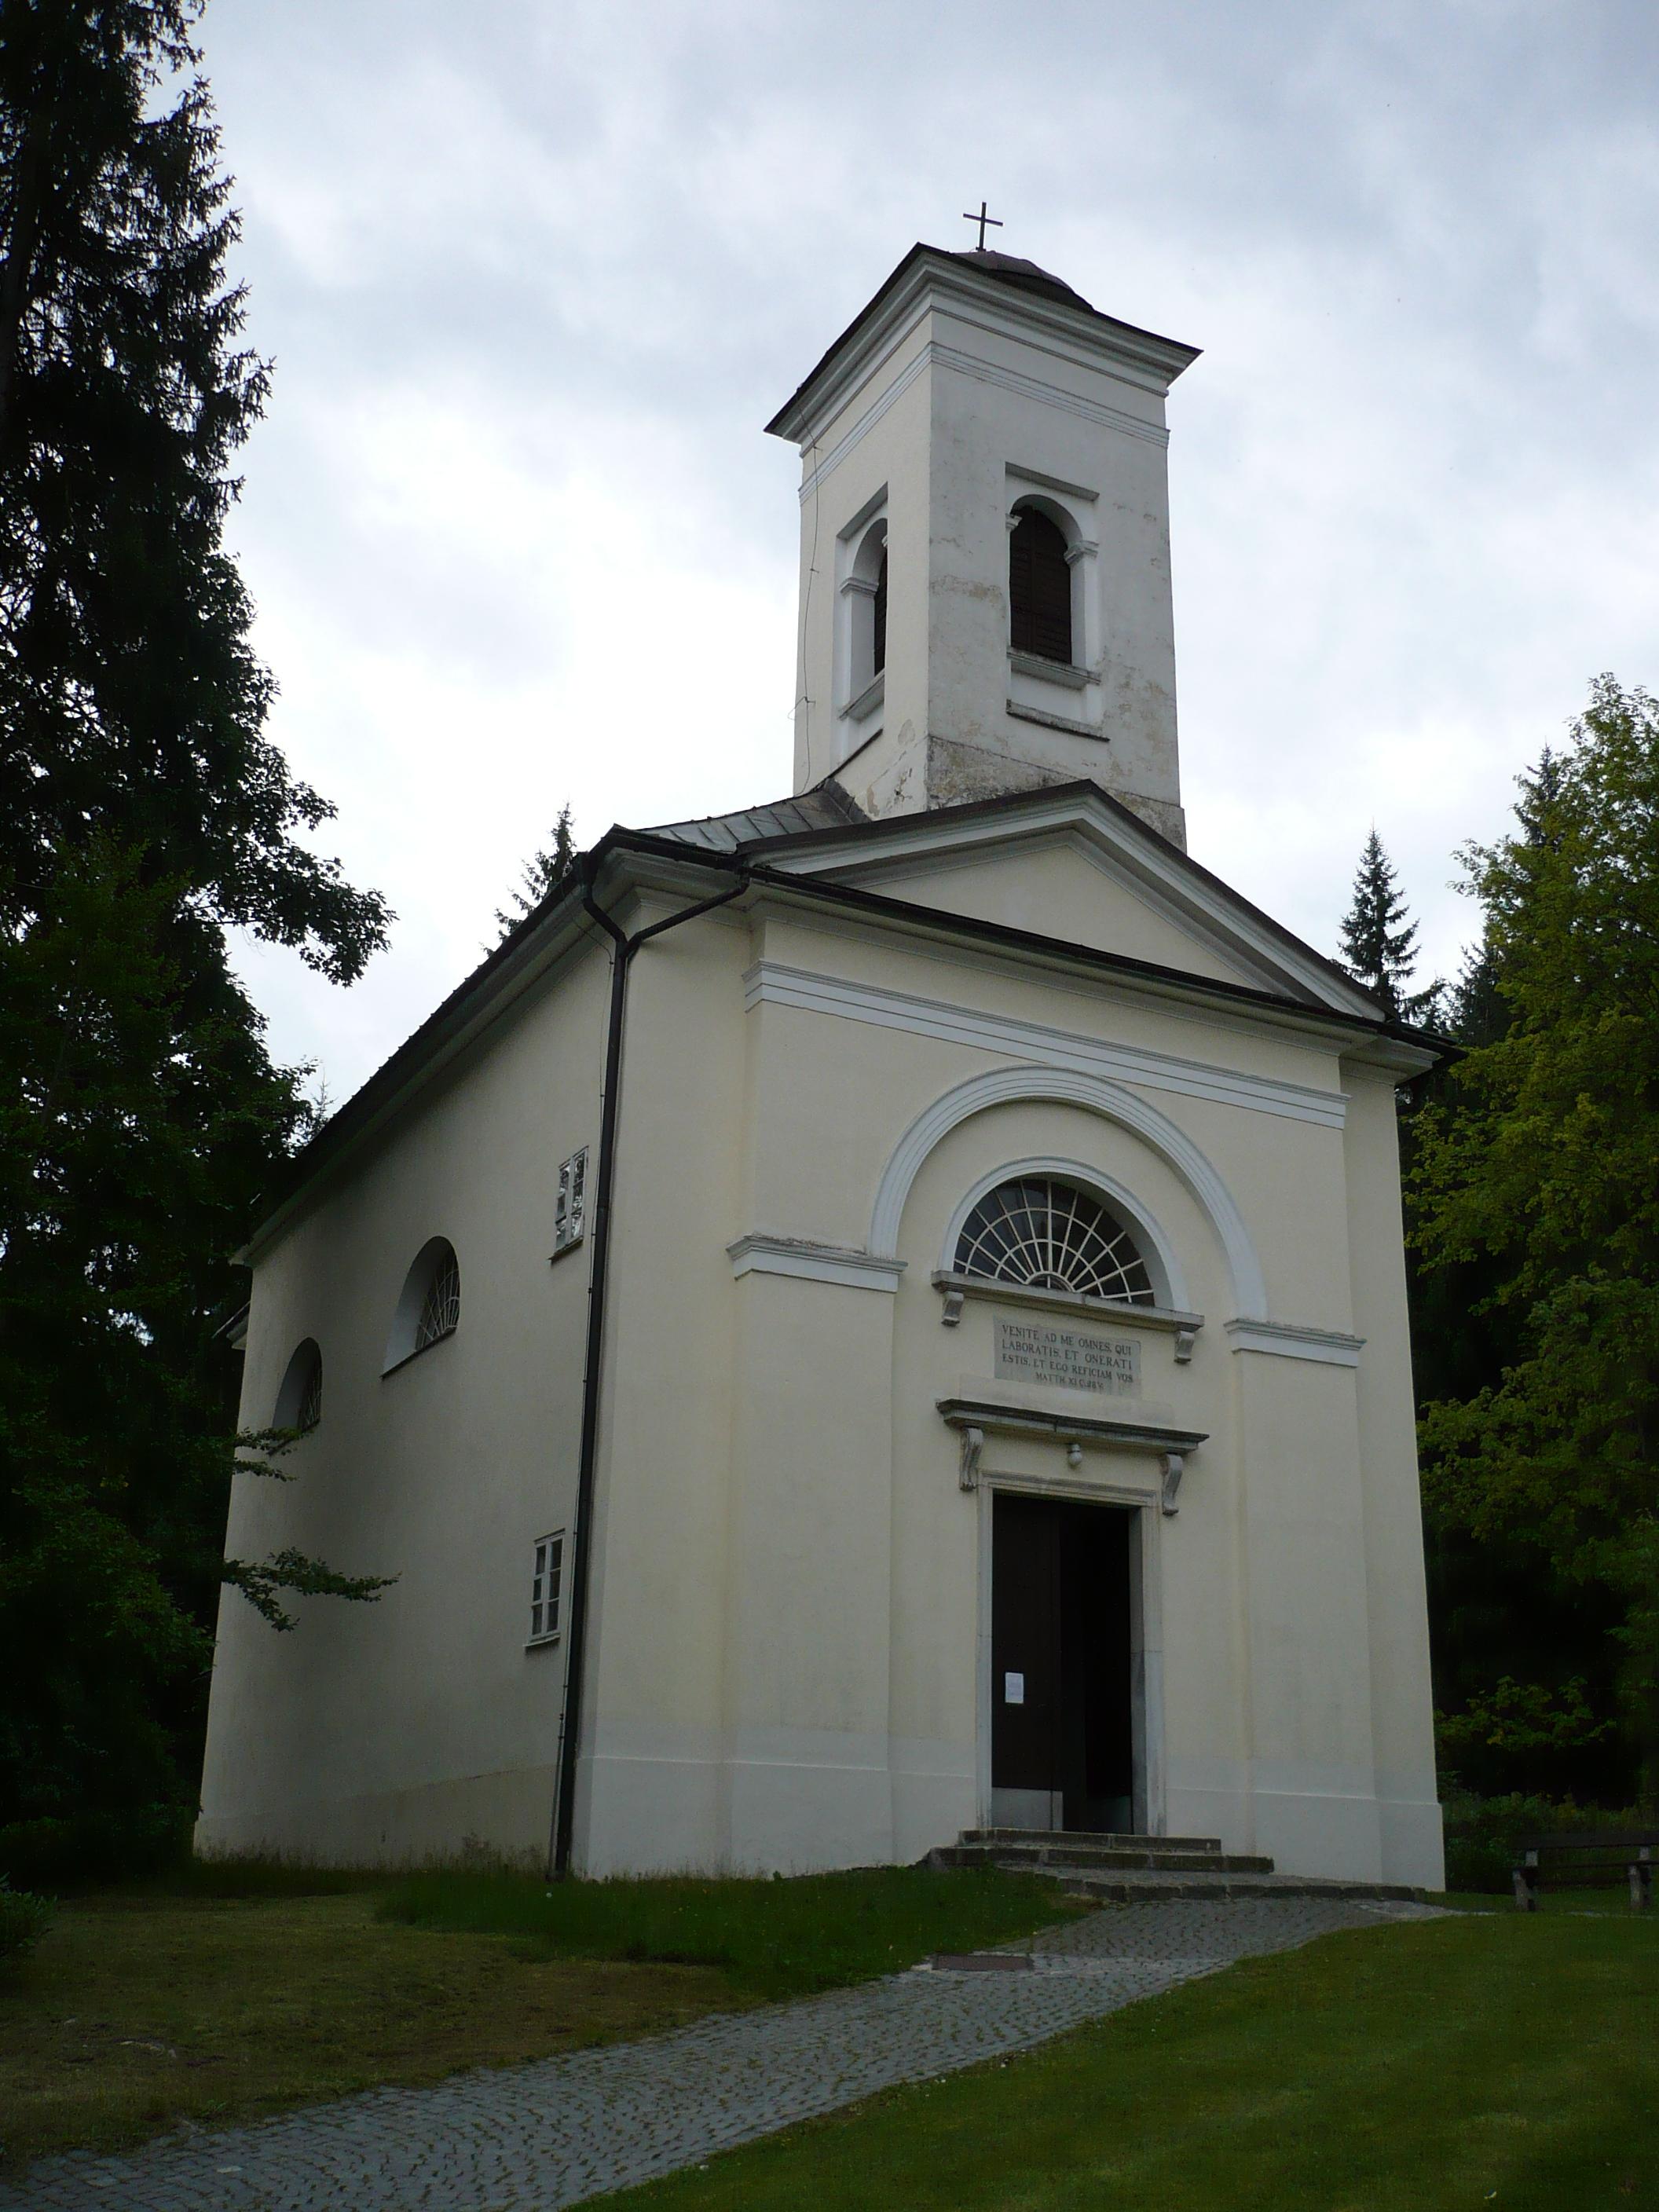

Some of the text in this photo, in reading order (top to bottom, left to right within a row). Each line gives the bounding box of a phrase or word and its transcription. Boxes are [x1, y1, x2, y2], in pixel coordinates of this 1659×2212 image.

[1044, 1333, 1057, 1342] AD
[1061, 1335, 1074, 1346] ME
[1115, 1344, 1131, 1357] QUI
[1034, 1359, 1046, 1369] ET
[1071, 1364, 1112, 1379] REFICIAM
[1116, 1372, 1133, 1382] VOS
[1064, 1350, 1079, 1361] ET
[1085, 1353, 1132, 1371] ONERATI
